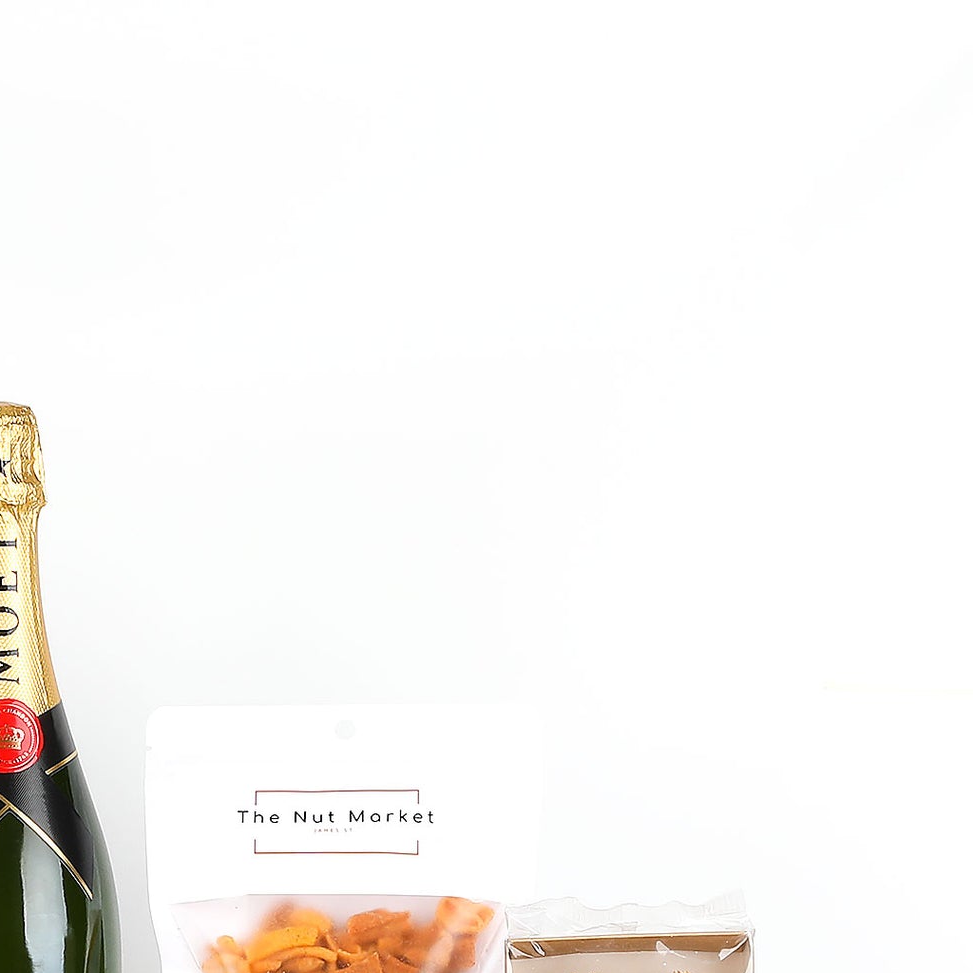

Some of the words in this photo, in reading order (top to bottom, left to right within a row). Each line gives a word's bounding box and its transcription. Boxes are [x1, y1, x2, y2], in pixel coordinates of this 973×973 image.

[237, 810, 280, 824] The
[294, 810, 335, 824] Nut
[349, 809, 434, 824] Market
